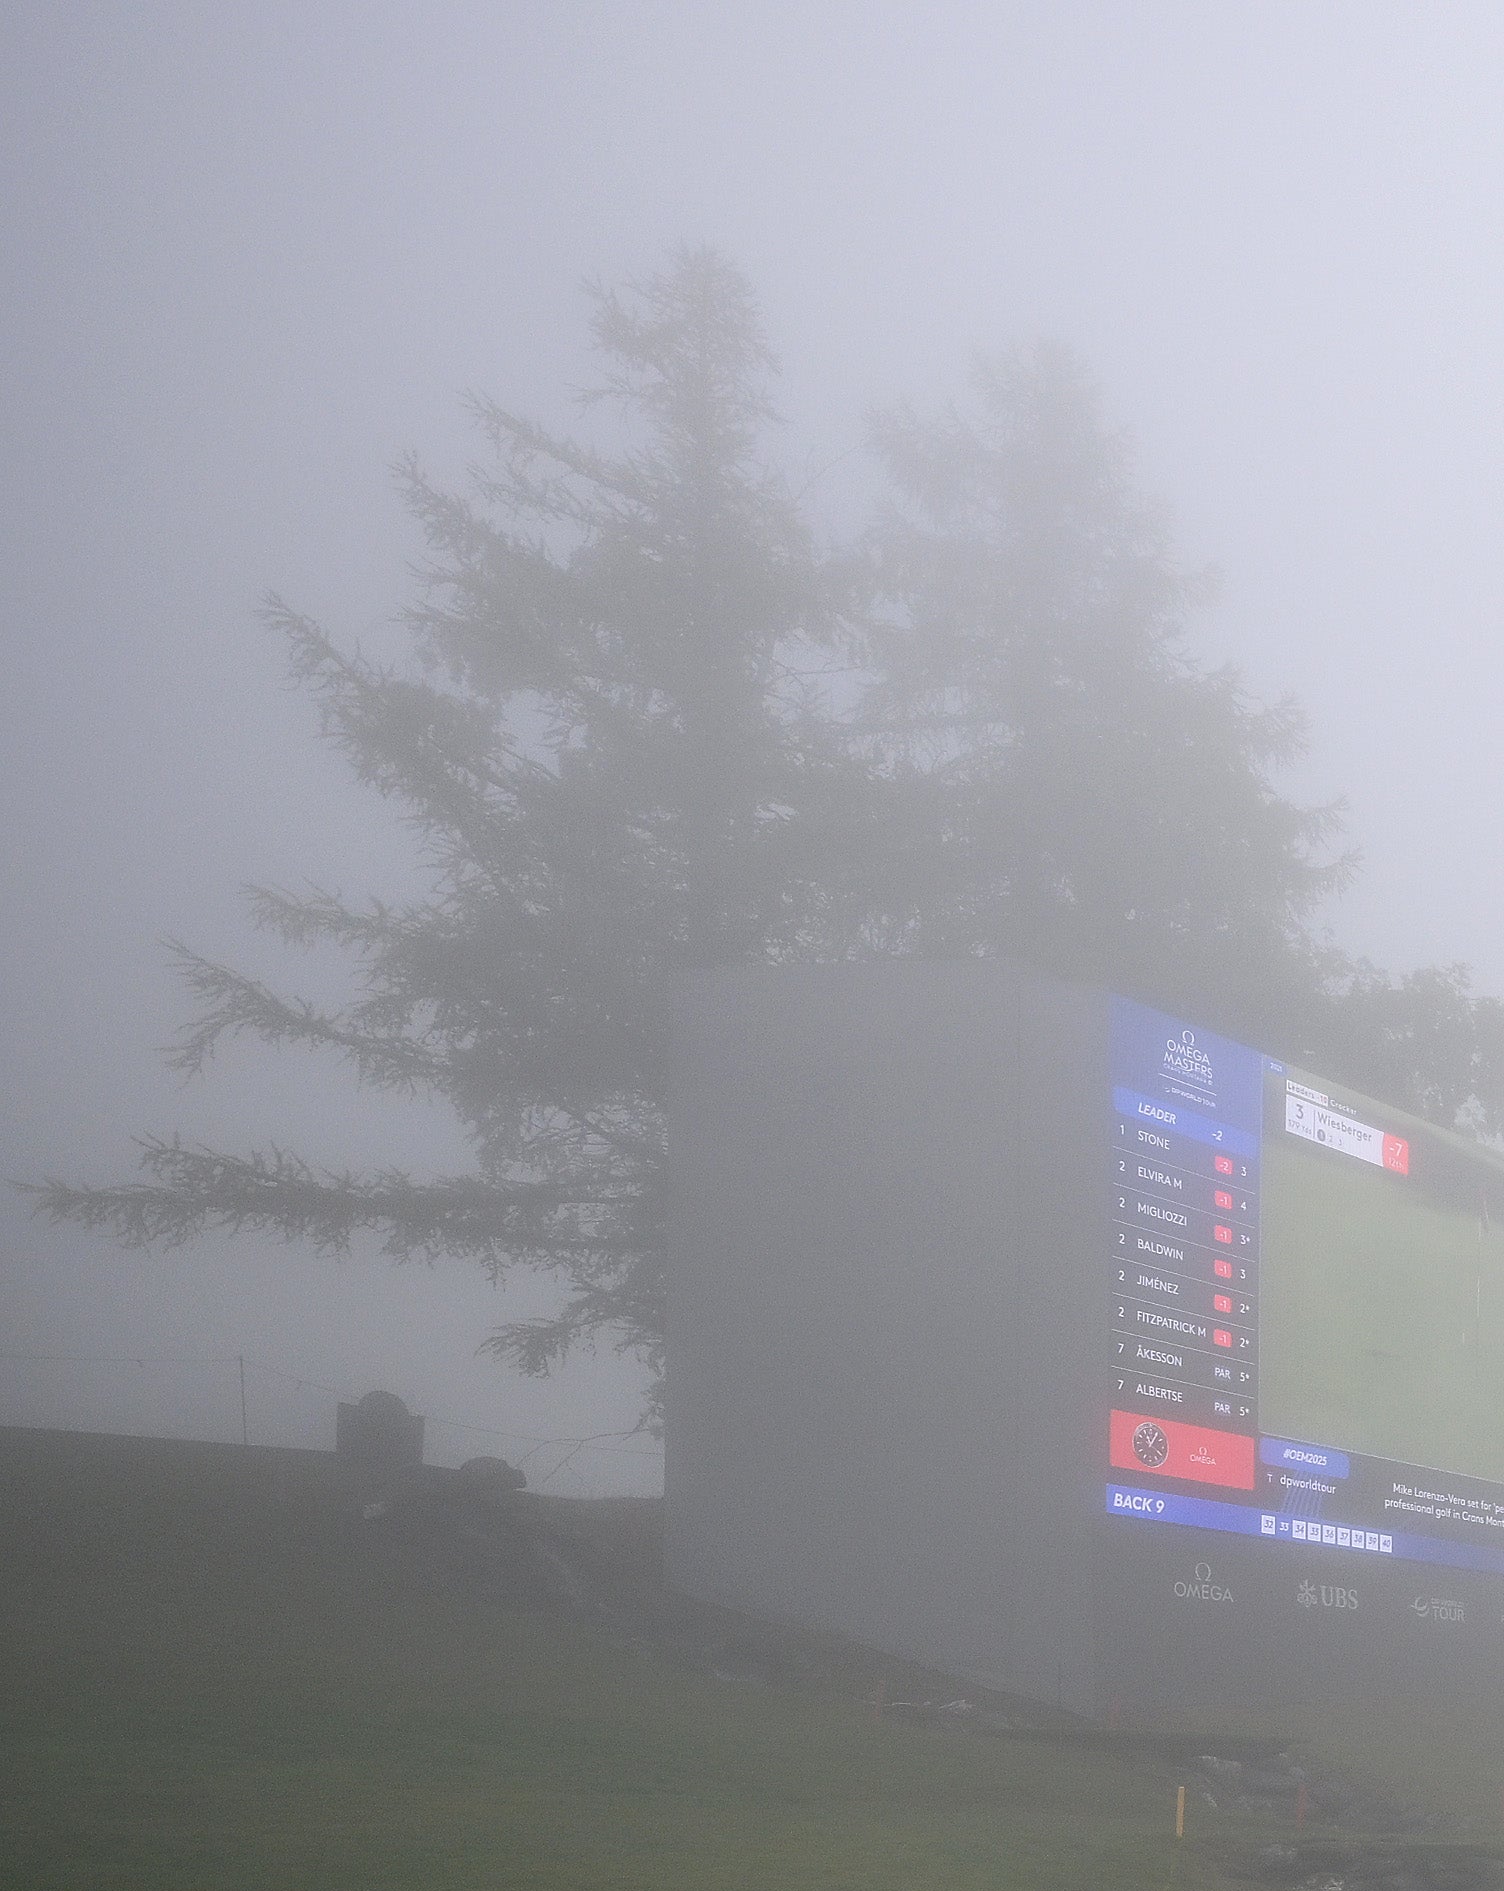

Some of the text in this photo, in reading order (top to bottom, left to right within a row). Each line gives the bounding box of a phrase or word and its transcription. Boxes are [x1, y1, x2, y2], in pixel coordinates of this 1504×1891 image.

[1164, 1051, 1213, 1079] MASTERS
[1167, 1039, 1210, 1066] OMEGA
[1288, 1082, 1315, 1099] Leaders
[1330, 1099, 1357, 1115] Crocker
[1138, 1102, 1223, 1141] LEADER -2
[1296, 1103, 1372, 1141] 3 Wiesberger
[1120, 1124, 1247, 1176] 1 STONE -2 3
[1389, 1143, 1402, 1156] -7
[1119, 1161, 1247, 1211] 2 ELVIRA M -1 4
[1119, 1197, 1125, 1208] 2
[1137, 1203, 1188, 1226] MIGLIOZZI
[1219, 1231, 1228, 1240] -1
[1119, 1234, 1246, 1279] 2 BALDWIN -1 3
[1119, 1270, 1125, 1281] 2
[1137, 1275, 1179, 1295] JIMÉNEZ
[1219, 1300, 1227, 1309] -1
[1118, 1307, 1124, 1317] 2
[1137, 1311, 1196, 1335] FITZPATRICK
[1198, 1326, 1206, 1337] M
[1219, 1334, 1227, 1343] -1
[1118, 1343, 1124, 1353] 7
[1137, 1344, 1183, 1366] ÅKESSON
[1214, 1367, 1231, 1380] PAR
[1117, 1380, 1123, 1390] 7
[1136, 1383, 1183, 1402] ALBERTSE
[1214, 1402, 1231, 1414] PAR
[1190, 1454, 1217, 1466] OMEGA
[1283, 1449, 1327, 1466] #OEM2025
[1280, 1475, 1336, 1494] dpworldtour
[1393, 1482, 1413, 1496] Mike
[1414, 1487, 1466, 1506] Lorenzo-Vera
[1467, 1499, 1479, 1508] set
[1481, 1500, 1491, 1510] for
[1113, 1493, 1165, 1513] BACK 9
[1384, 1499, 1434, 1514] professional
[1435, 1507, 1451, 1519] golf
[1452, 1509, 1461, 1520] in
[1462, 1511, 1484, 1524] Crans
[1264, 1520, 1391, 1547] 32 33 34 35 36 37 38 39 40
[1174, 1582, 1234, 1603] OMEGA
[1319, 1585, 1359, 1610] UBS
[1433, 1606, 1465, 1621] TOUR
